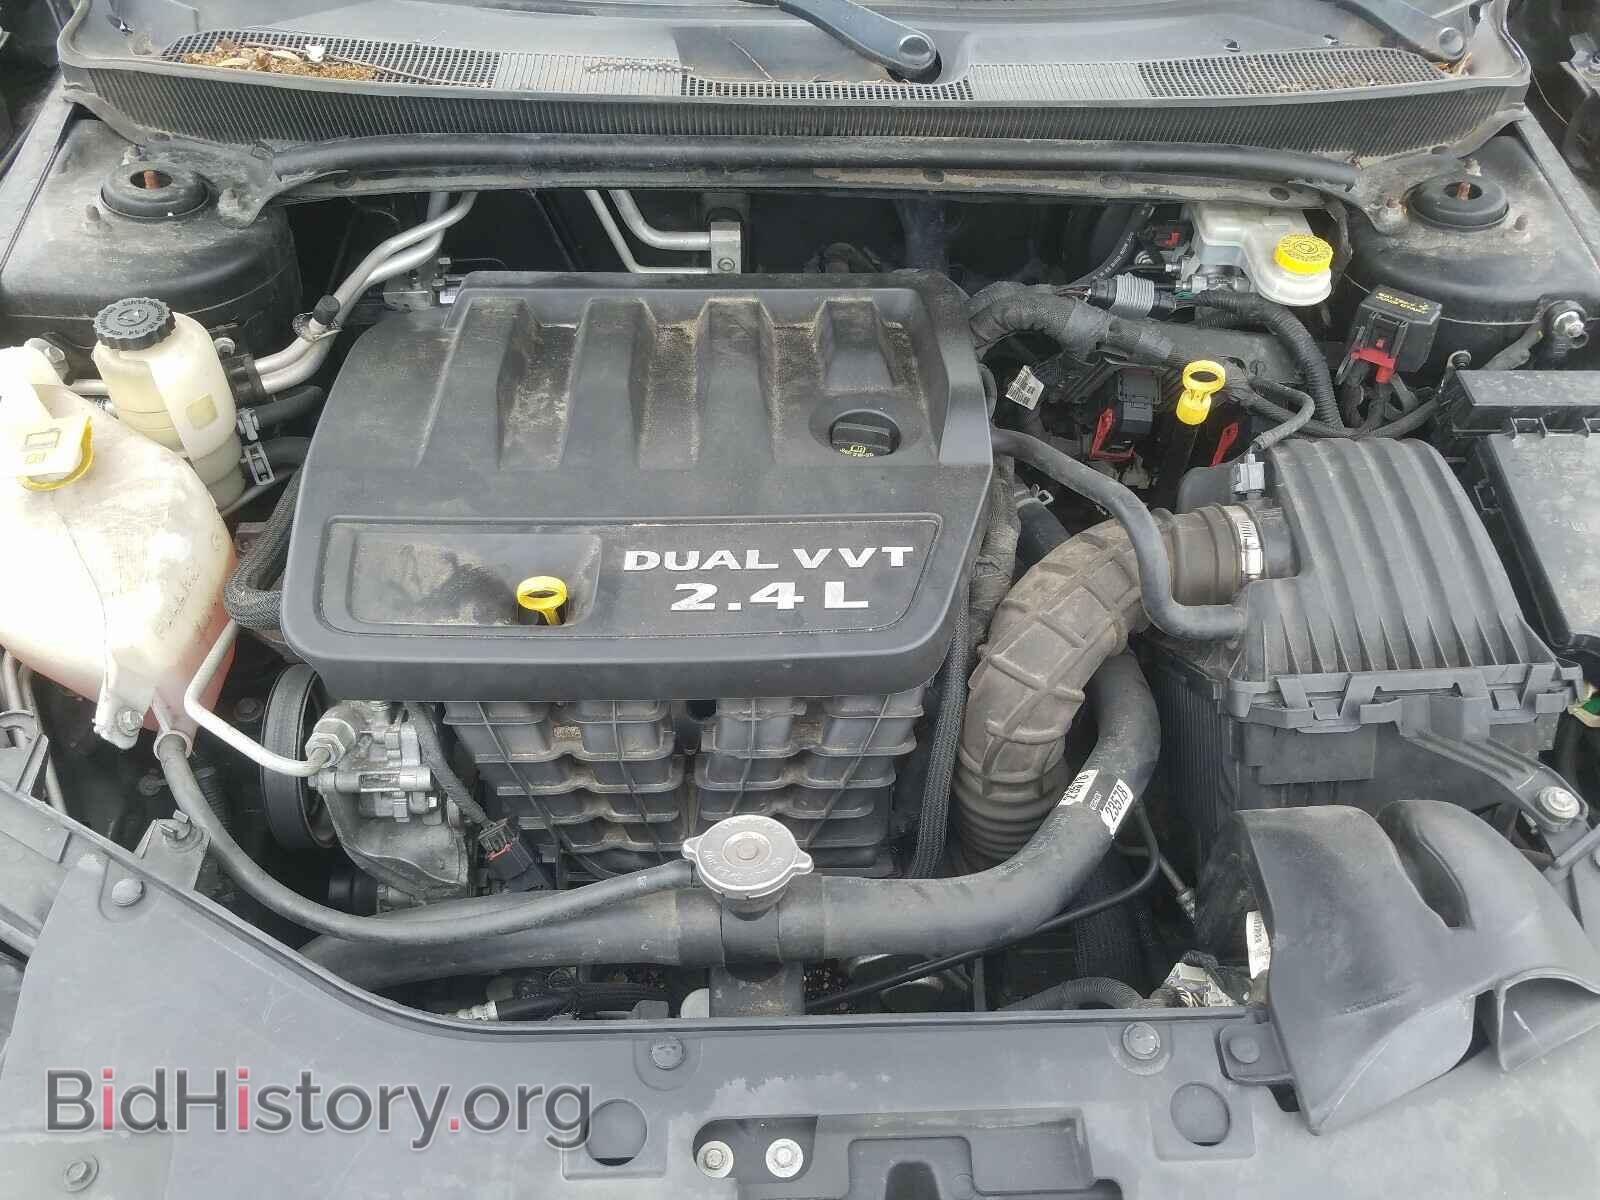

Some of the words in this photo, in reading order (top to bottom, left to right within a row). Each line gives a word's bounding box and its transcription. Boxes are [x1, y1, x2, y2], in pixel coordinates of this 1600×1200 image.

[623, 549, 779, 571] DUAL
[793, 546, 914, 569] VVT
[1104, 784, 1129, 822] 23578
